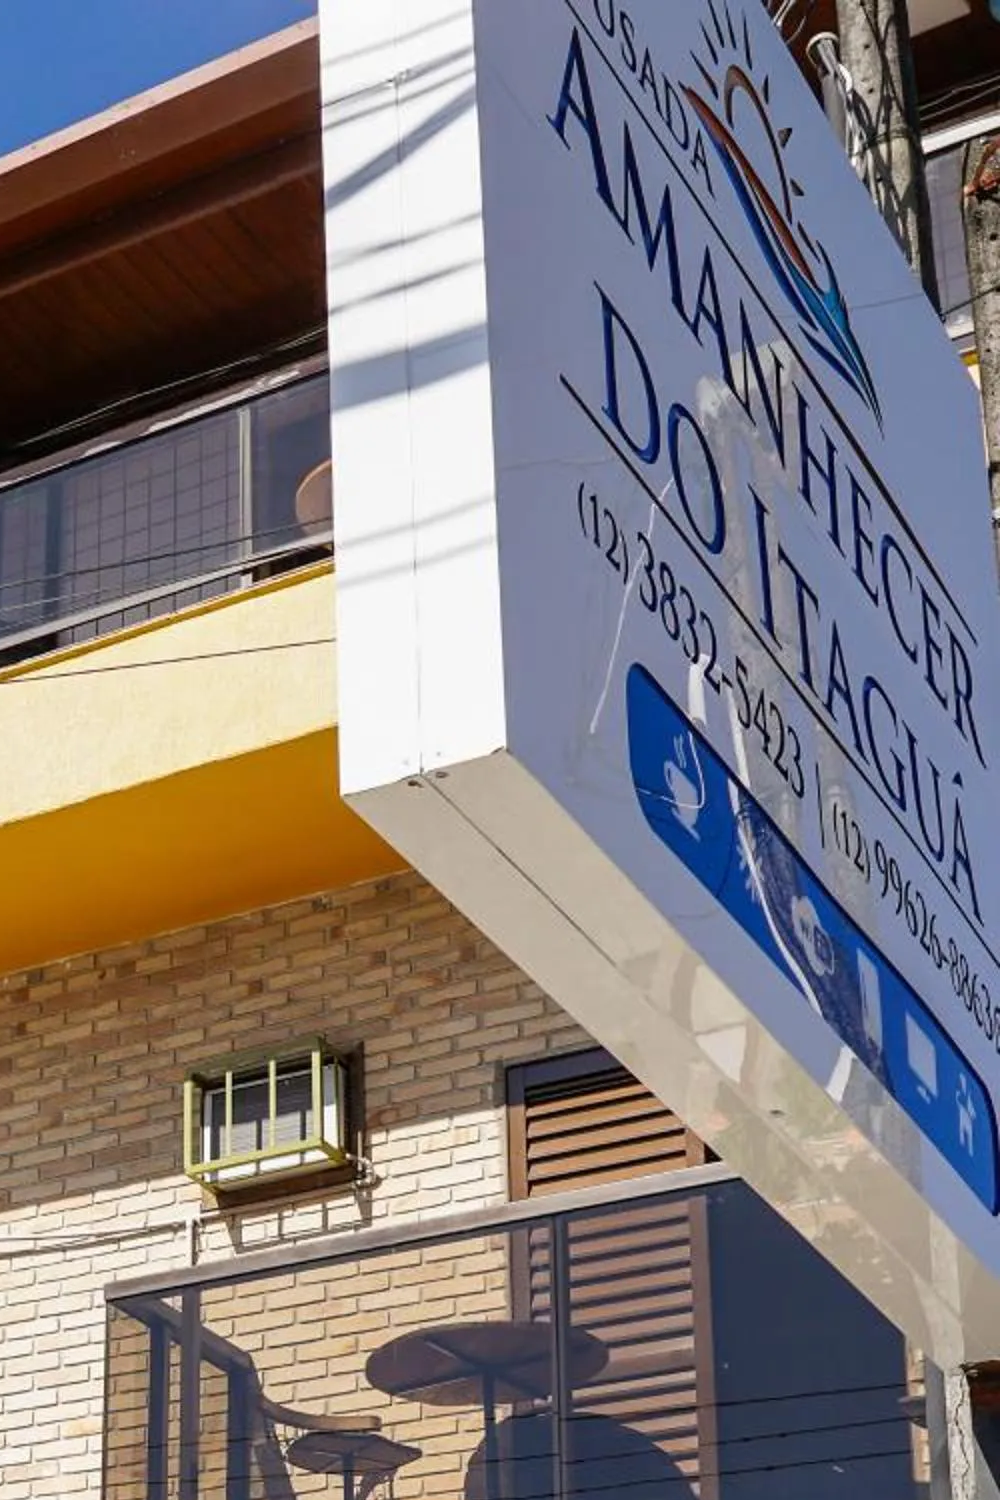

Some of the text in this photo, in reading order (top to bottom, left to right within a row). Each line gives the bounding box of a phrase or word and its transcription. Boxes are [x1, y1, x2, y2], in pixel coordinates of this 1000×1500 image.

[546, 26, 987, 770] AMANHECER
[577, 482, 629, 585] (12)
[637, 531, 805, 798] 3832-5423
[832, 802, 871, 884] (12)
[594, 280, 985, 927] DO ITAGUÁ
